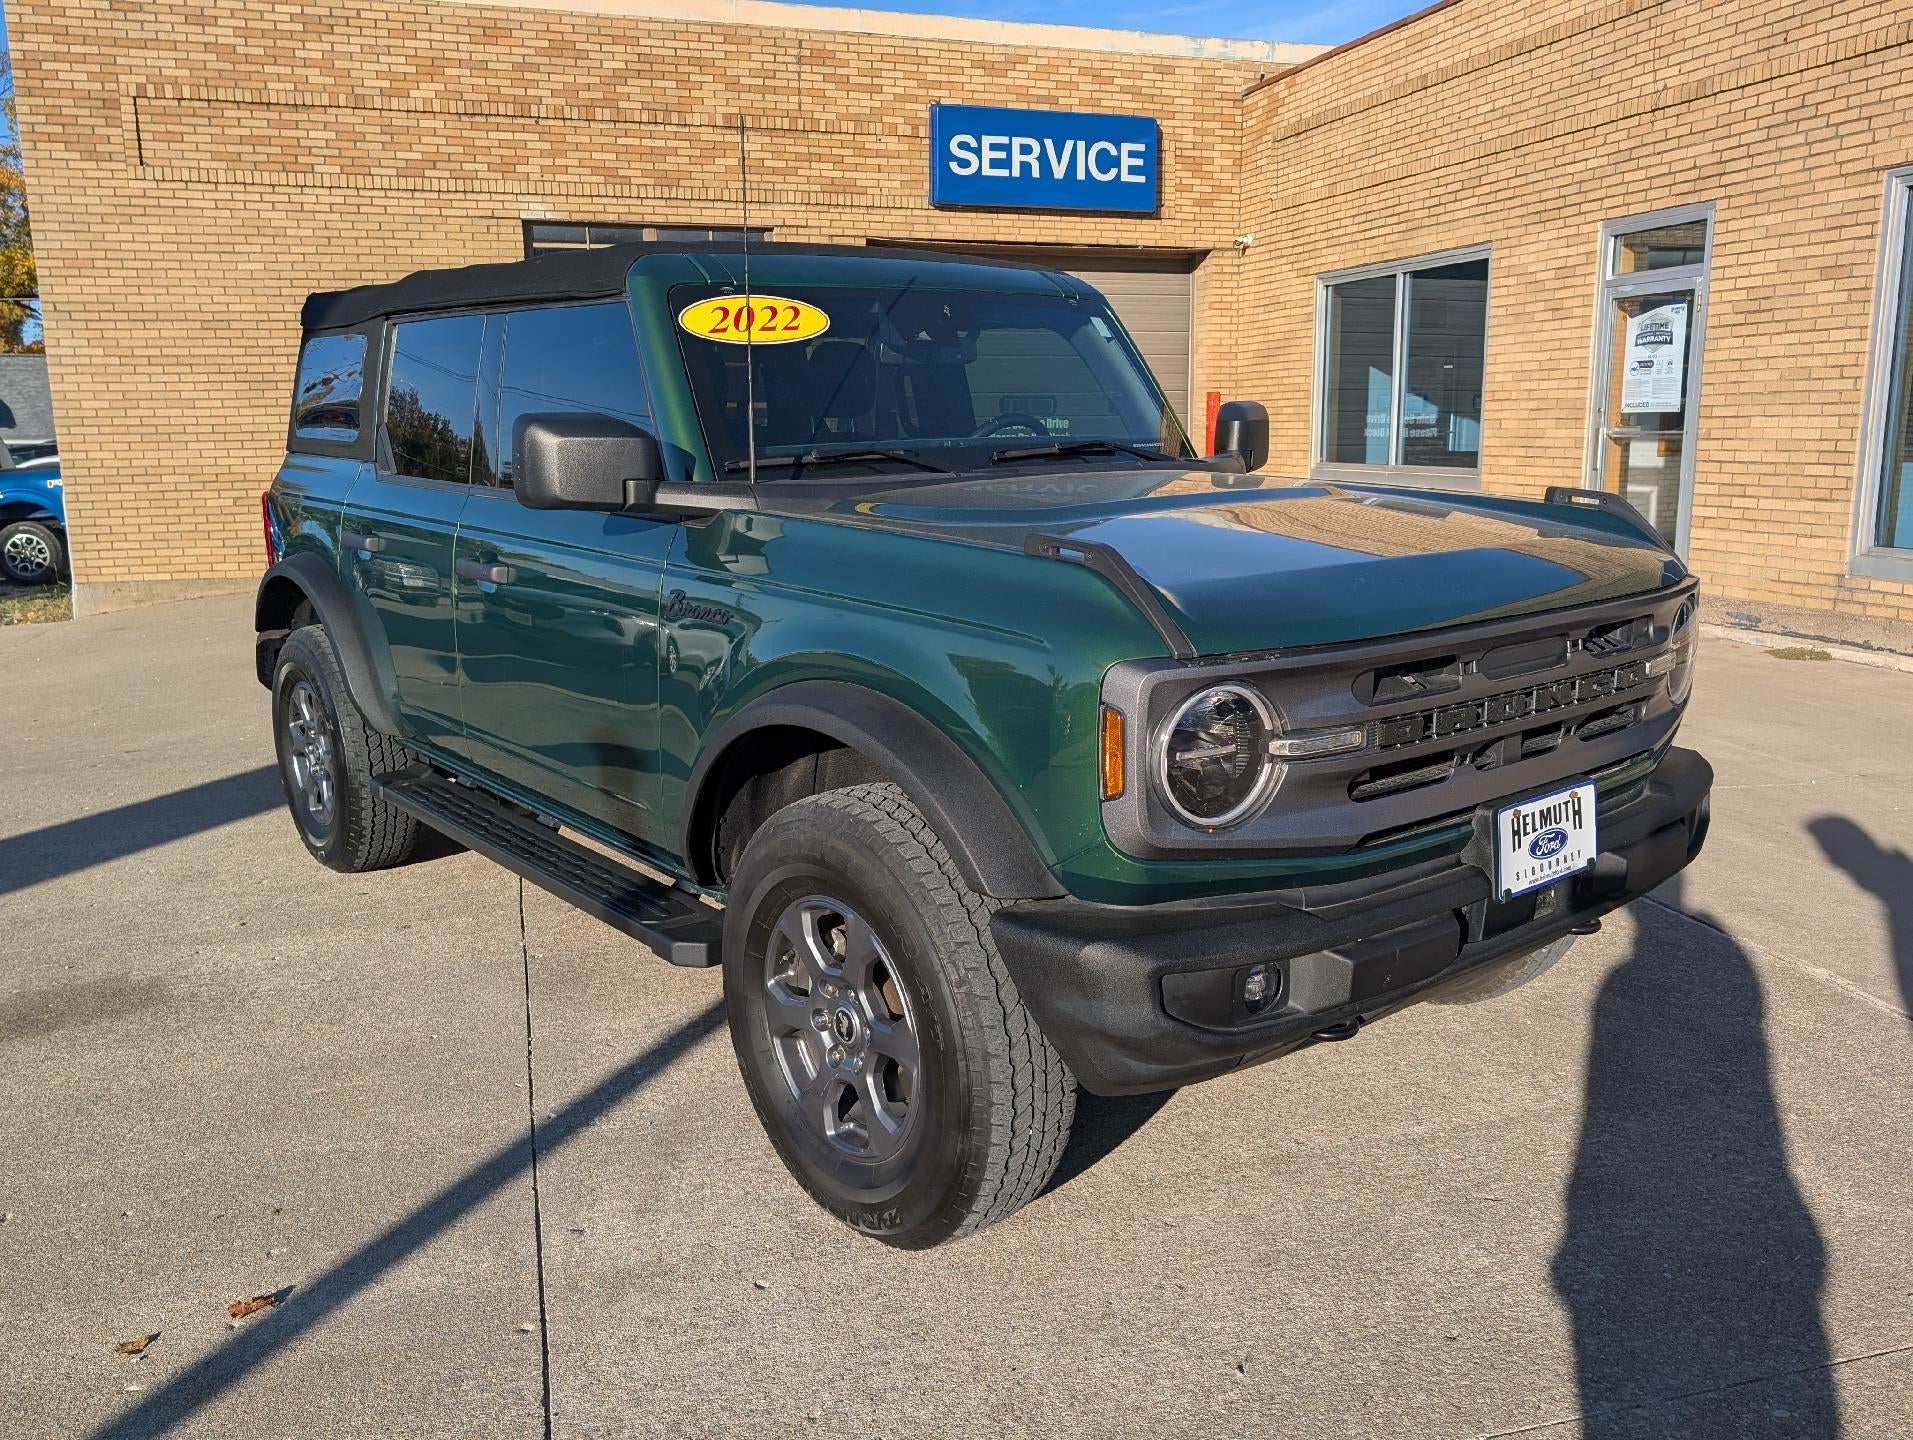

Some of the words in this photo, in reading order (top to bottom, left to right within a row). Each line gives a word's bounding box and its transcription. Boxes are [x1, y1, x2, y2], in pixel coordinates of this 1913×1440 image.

[948, 134, 1147, 183] SERVICE
[708, 305, 801, 334] 2022
[1640, 321, 1670, 331] LIFETIME
[1636, 335, 1672, 345] WARRANTY
[1046, 417, 1069, 429] Drive
[664, 589, 734, 625] Bronco
[1377, 664, 1647, 749] BRONCO
[1511, 796, 1583, 853] HELMUTH
[1535, 832, 1562, 856] Ford
[1515, 849, 1582, 882] SIGOURNEY
